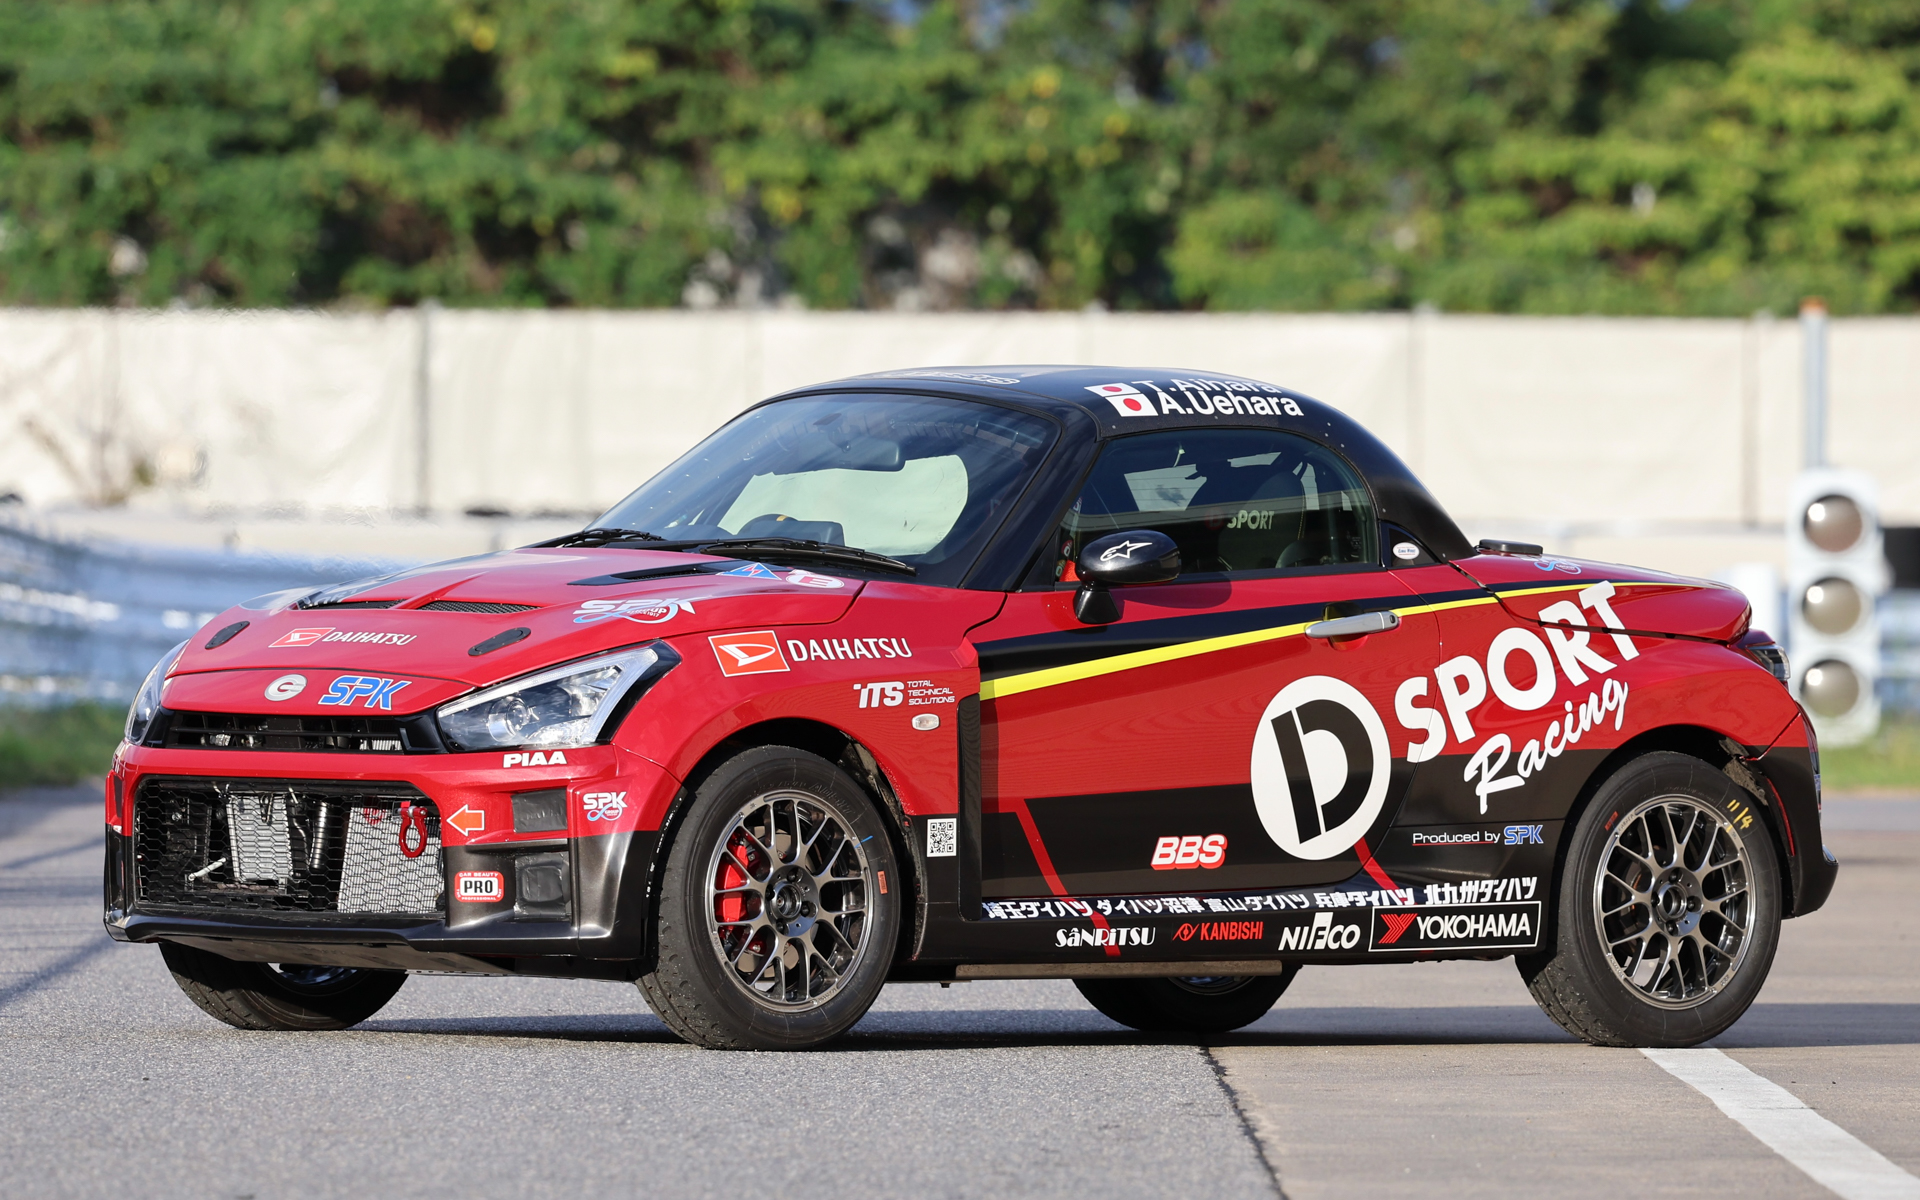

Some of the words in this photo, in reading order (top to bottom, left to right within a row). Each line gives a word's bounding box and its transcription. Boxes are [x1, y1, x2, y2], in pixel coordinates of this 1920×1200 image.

[1157, 390, 1304, 417] A.Uehara
[322, 631, 417, 646] DAIHATSU
[787, 638, 913, 662] DAIHATSU
[1394, 580, 1640, 763] SPORT
[318, 675, 412, 711] SPK
[907, 680, 934, 688] TOTAL
[908, 687, 953, 697] TECHNICAL
[908, 695, 955, 706] SOLUTIONS
[1464, 677, 1629, 814] Racing
[503, 751, 568, 768] PIAA
[583, 791, 628, 810] SPK
[1412, 831, 1480, 844] Produced
[1484, 831, 1501, 844] by
[1504, 825, 1544, 846] SPK
[1150, 833, 1228, 871] BBS
[464, 880, 493, 894] PRO
[982, 901, 1094, 920] 埼玉ダイハツ
[1097, 897, 1205, 916] ダイハツ沼津
[1203, 893, 1311, 913] 富山ダイハツ
[1313, 888, 1415, 909] 兵庫ダイハツ
[1424, 877, 1538, 905] 北九州ダイハツ
[1200, 921, 1264, 941] KANBISHI
[1416, 913, 1531, 939] YOKOHAMA
